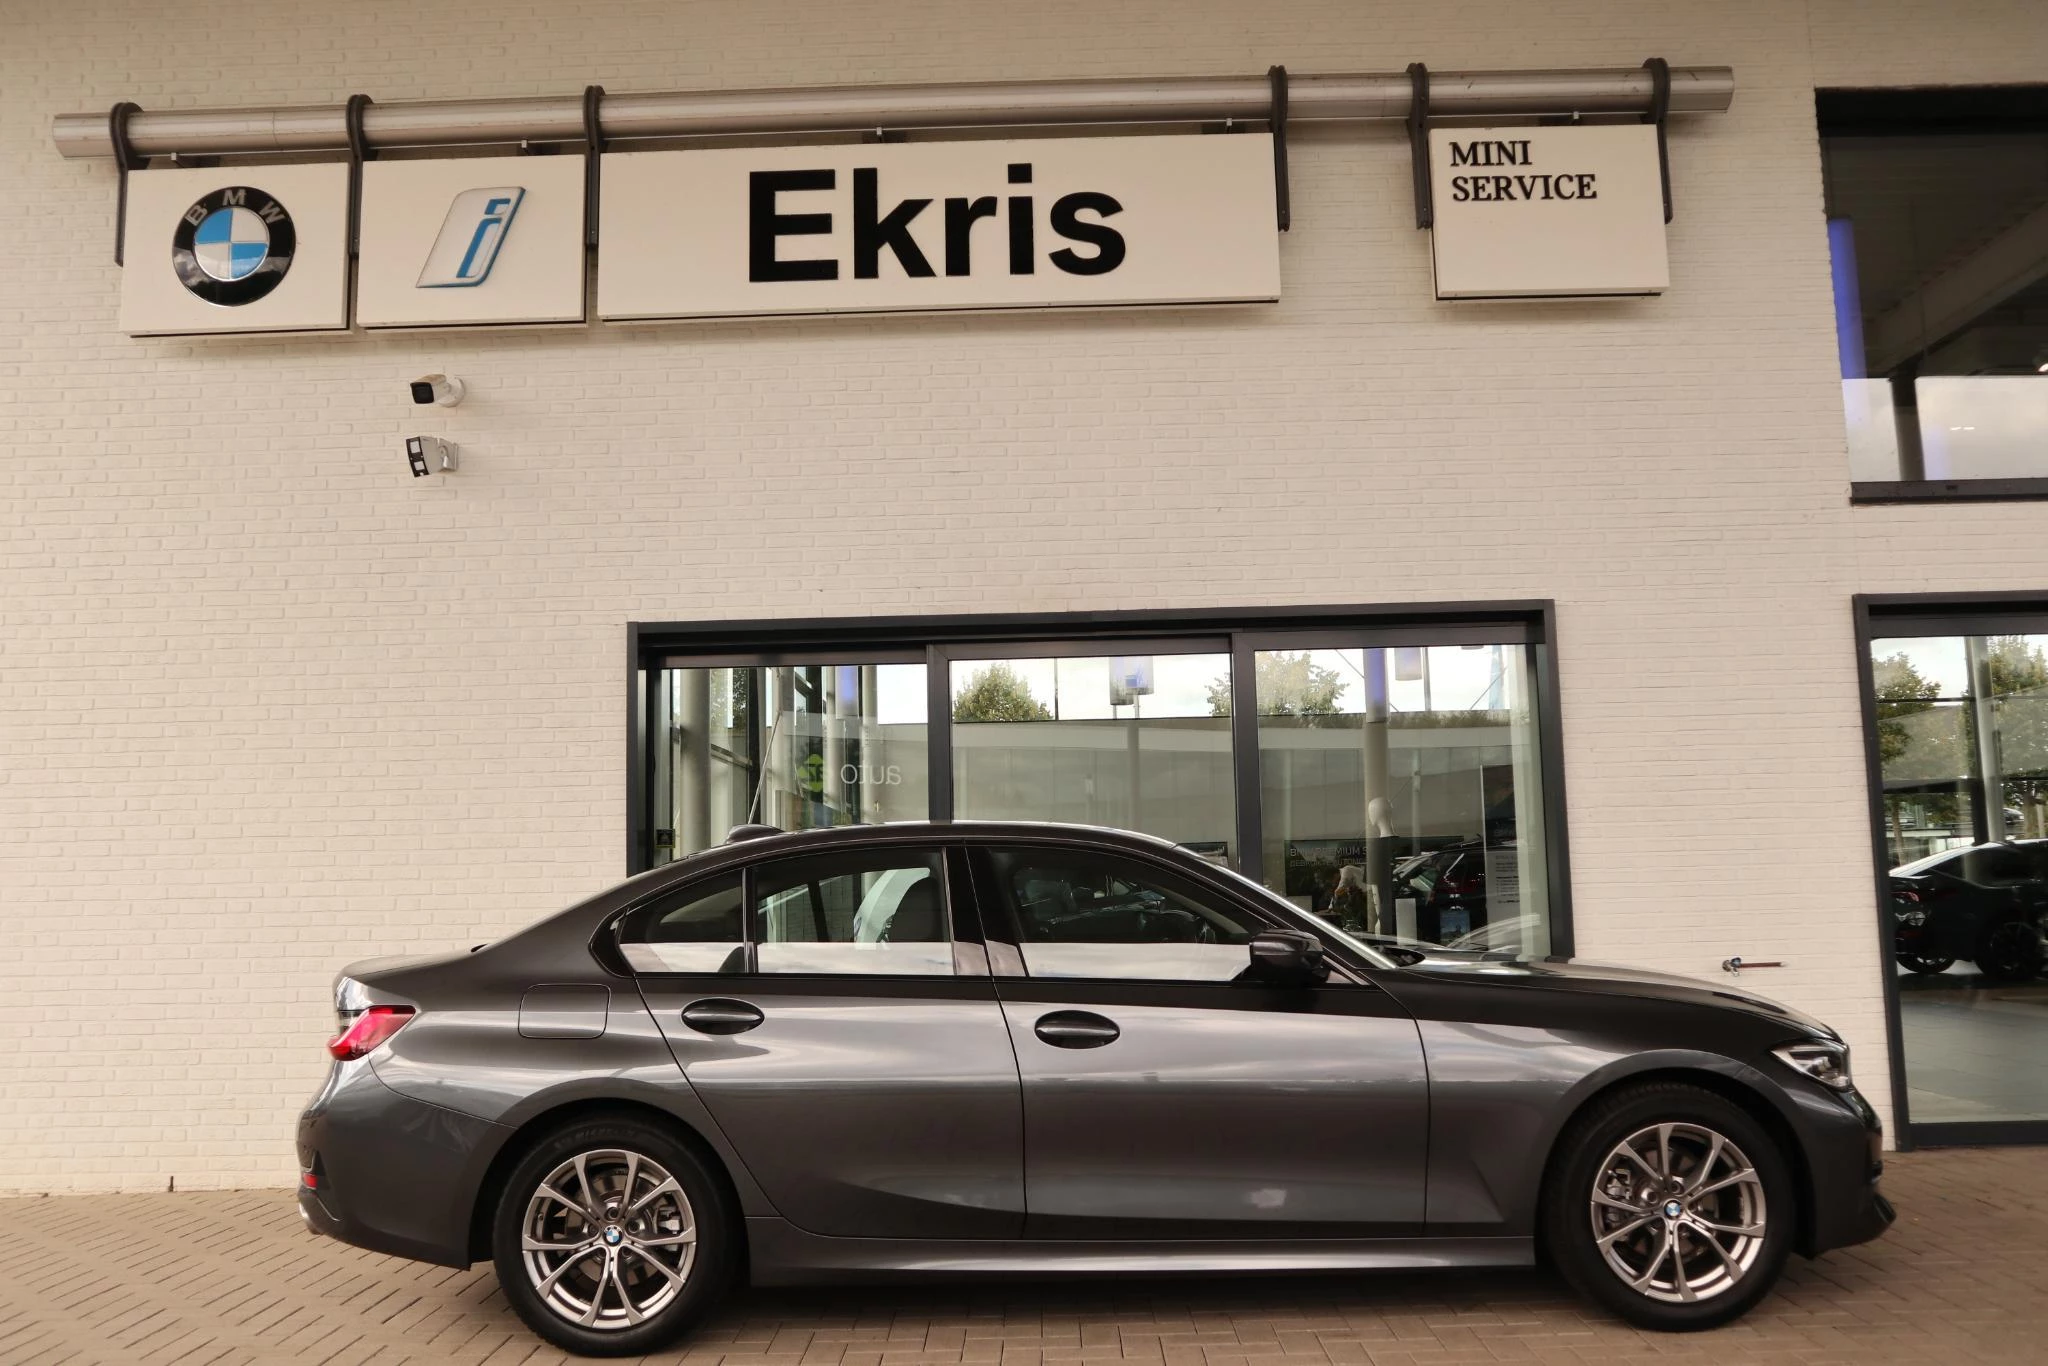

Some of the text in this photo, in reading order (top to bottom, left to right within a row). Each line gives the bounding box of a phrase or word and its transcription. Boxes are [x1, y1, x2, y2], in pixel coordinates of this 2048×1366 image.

[1449, 140, 1533, 166] MINI
[1451, 174, 1597, 201] SERVICE
[184, 189, 286, 226] BMW
[749, 163, 1127, 283] Ekris
[1315, 846, 1361, 856] PREMIUM
